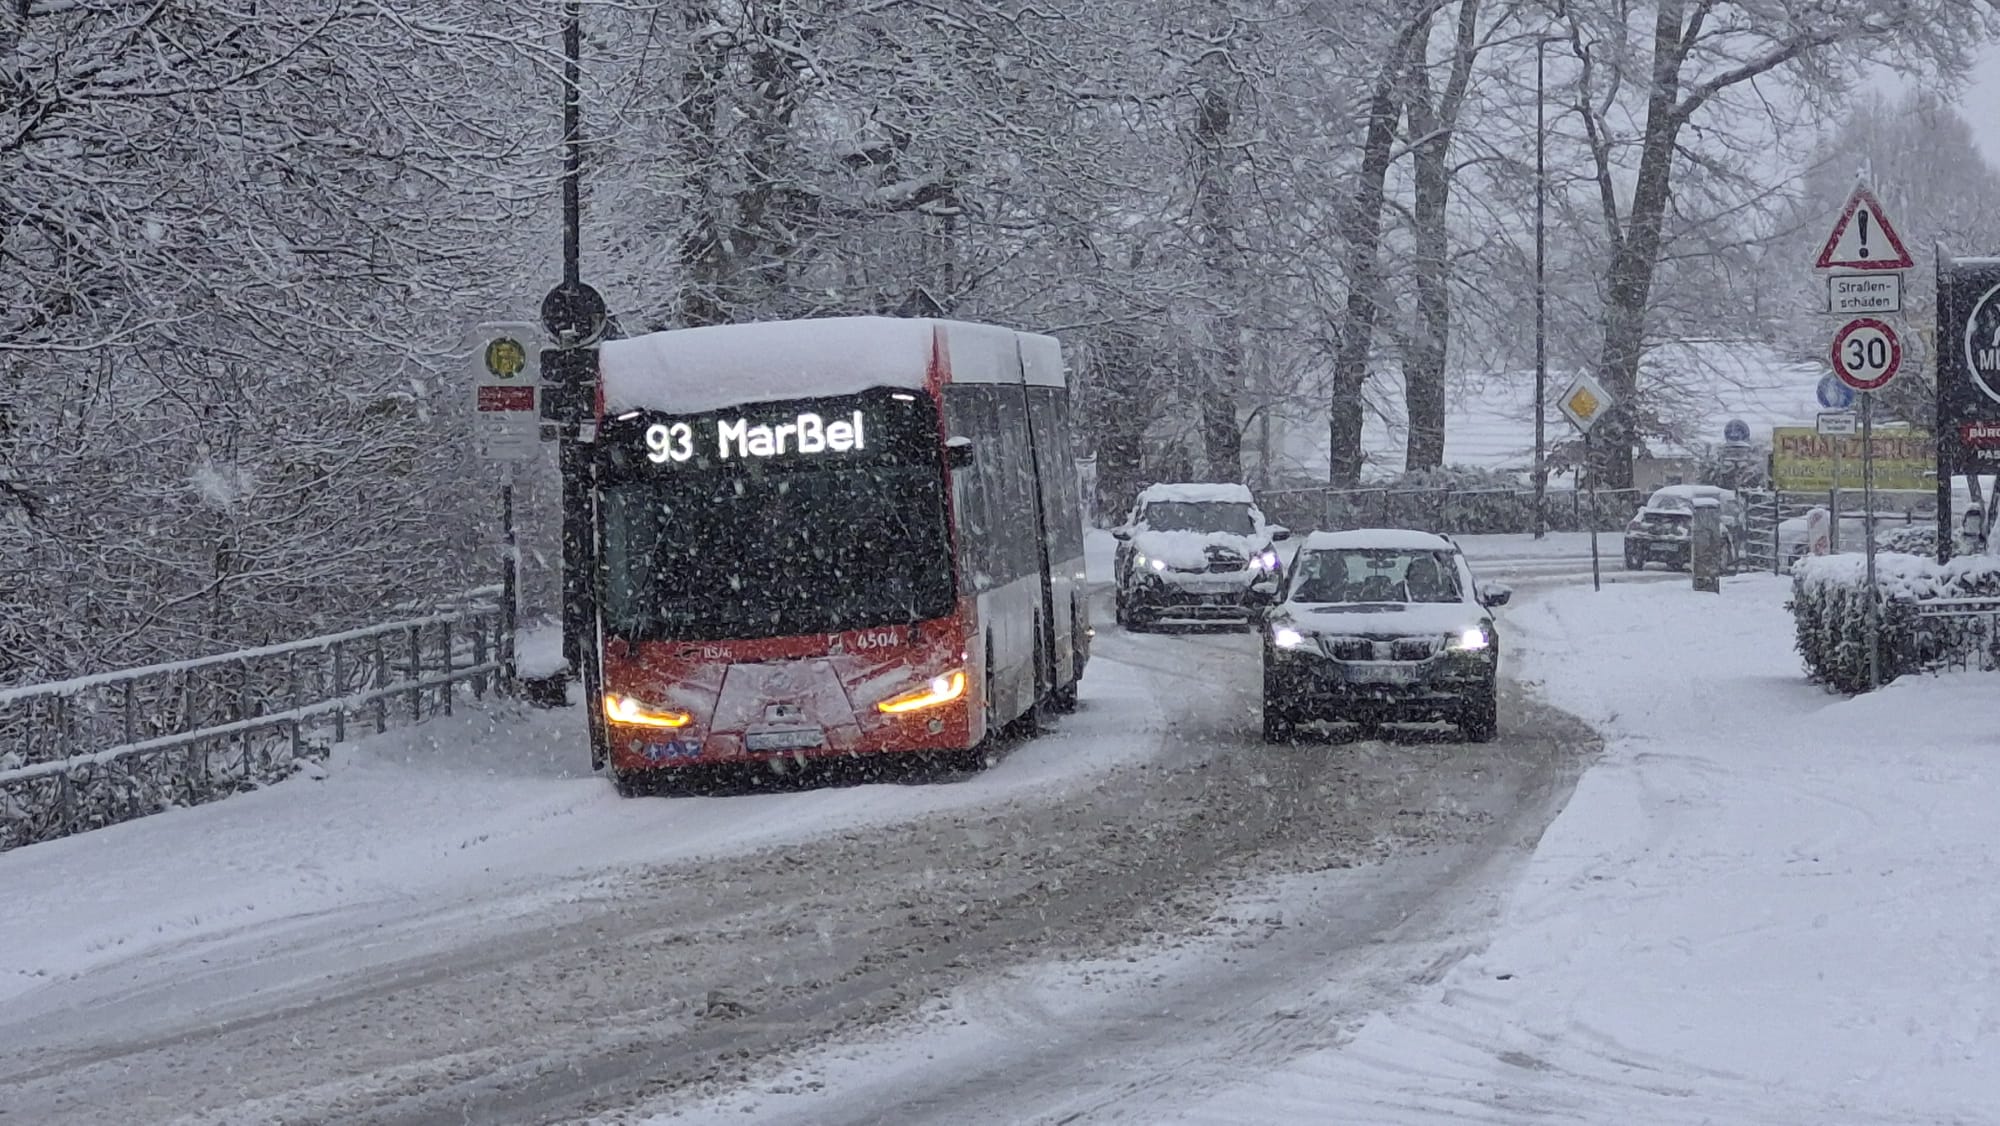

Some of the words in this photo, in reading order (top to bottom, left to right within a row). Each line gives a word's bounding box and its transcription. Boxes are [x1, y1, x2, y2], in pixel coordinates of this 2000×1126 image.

[1838, 280, 1892, 293] Straßen-
[1846, 337, 1886, 370] 30
[646, 422, 693, 463] 93
[857, 631, 898, 649] 4504
